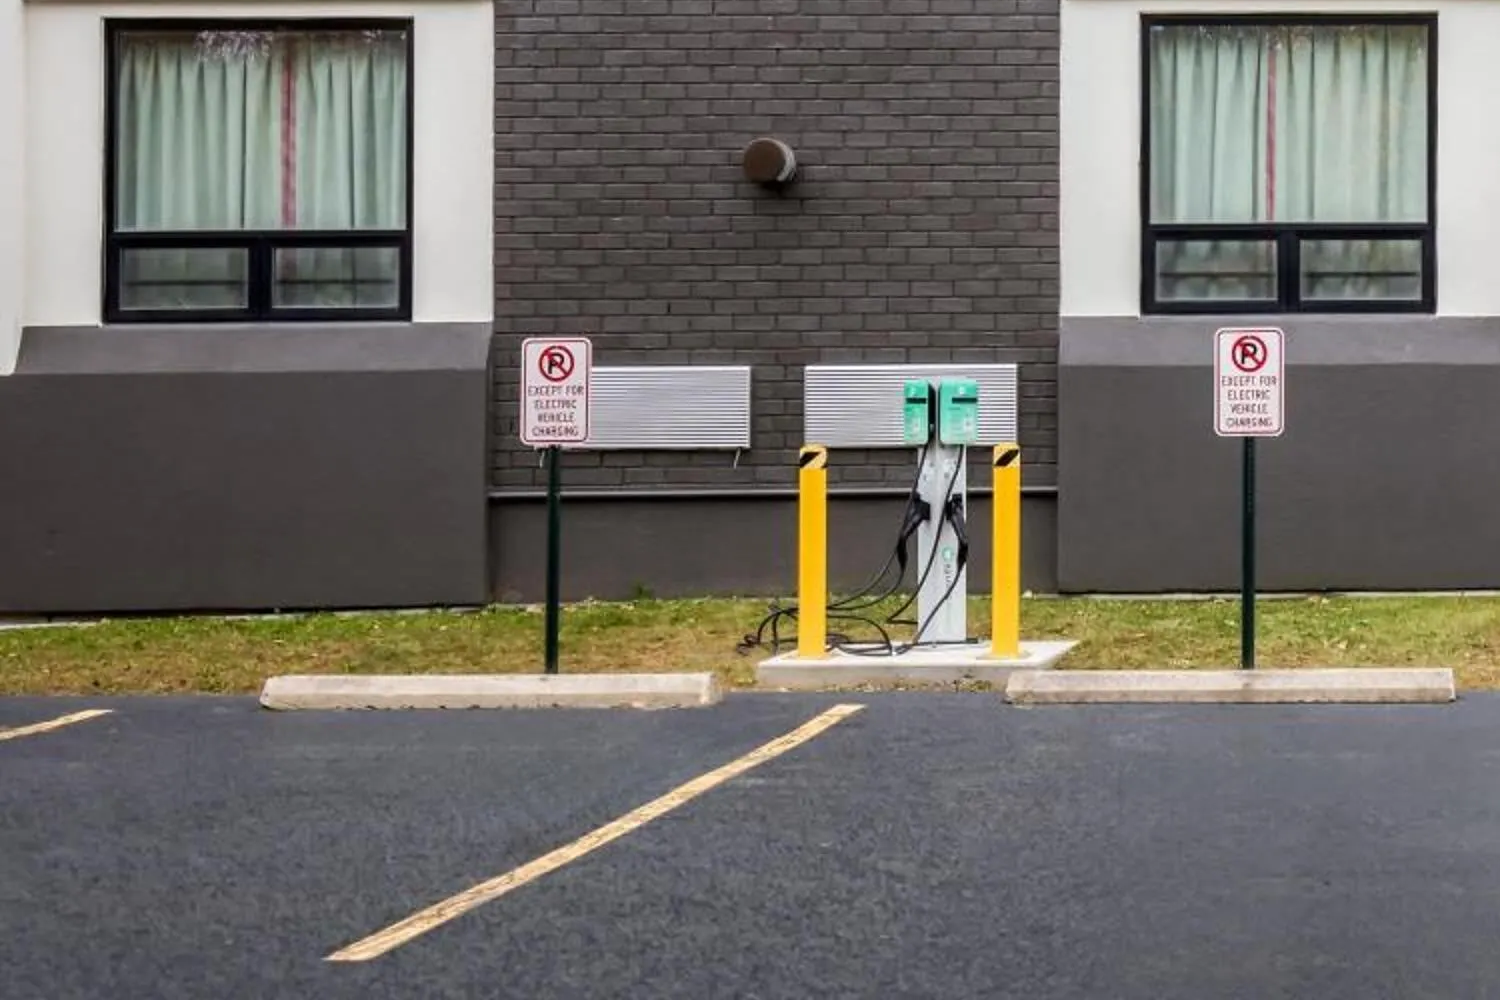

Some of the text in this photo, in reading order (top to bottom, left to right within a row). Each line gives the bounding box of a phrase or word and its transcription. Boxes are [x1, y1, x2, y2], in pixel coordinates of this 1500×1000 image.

[1221, 375, 1277, 386] EXCEPT FOR
[527, 385, 584, 396] EXCEPT FOR
[1227, 389, 1270, 401] ELECTRIC
[534, 399, 577, 409] ELECTRIC
[1230, 403, 1268, 414] VEHICLE
[537, 412, 575, 422] VEHICLE
[1225, 417, 1273, 428] CHARGING
[531, 426, 578, 437] CHARGING
